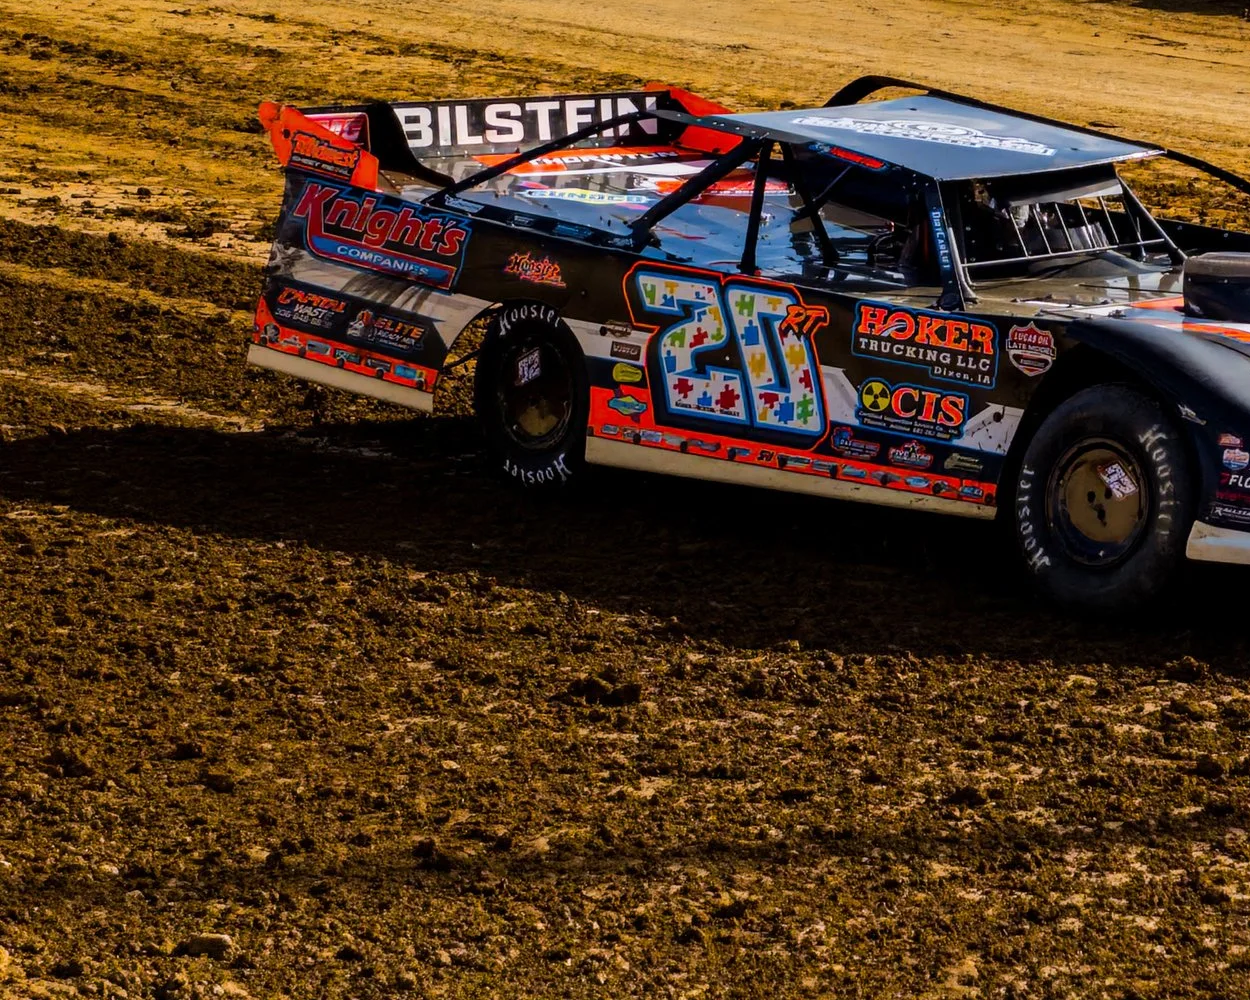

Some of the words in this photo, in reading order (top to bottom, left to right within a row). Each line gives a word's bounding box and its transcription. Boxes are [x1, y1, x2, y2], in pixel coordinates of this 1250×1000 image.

[393, 96, 659, 148] BILSTEIN
[528, 151, 679, 167] THORNTON
[293, 183, 467, 257] Knight's
[337, 245, 430, 277] COMPANIES
[374, 317, 425, 339] ELITE
[779, 303, 826, 334] RT
[858, 304, 995, 356] HOKER
[859, 337, 951, 365] TRUCKING
[956, 354, 991, 372] LLC
[1013, 331, 1037, 343] LUCAS
[1037, 335, 1049, 346] OIL
[977, 374, 991, 385] IA
[891, 387, 966, 427] CIS
